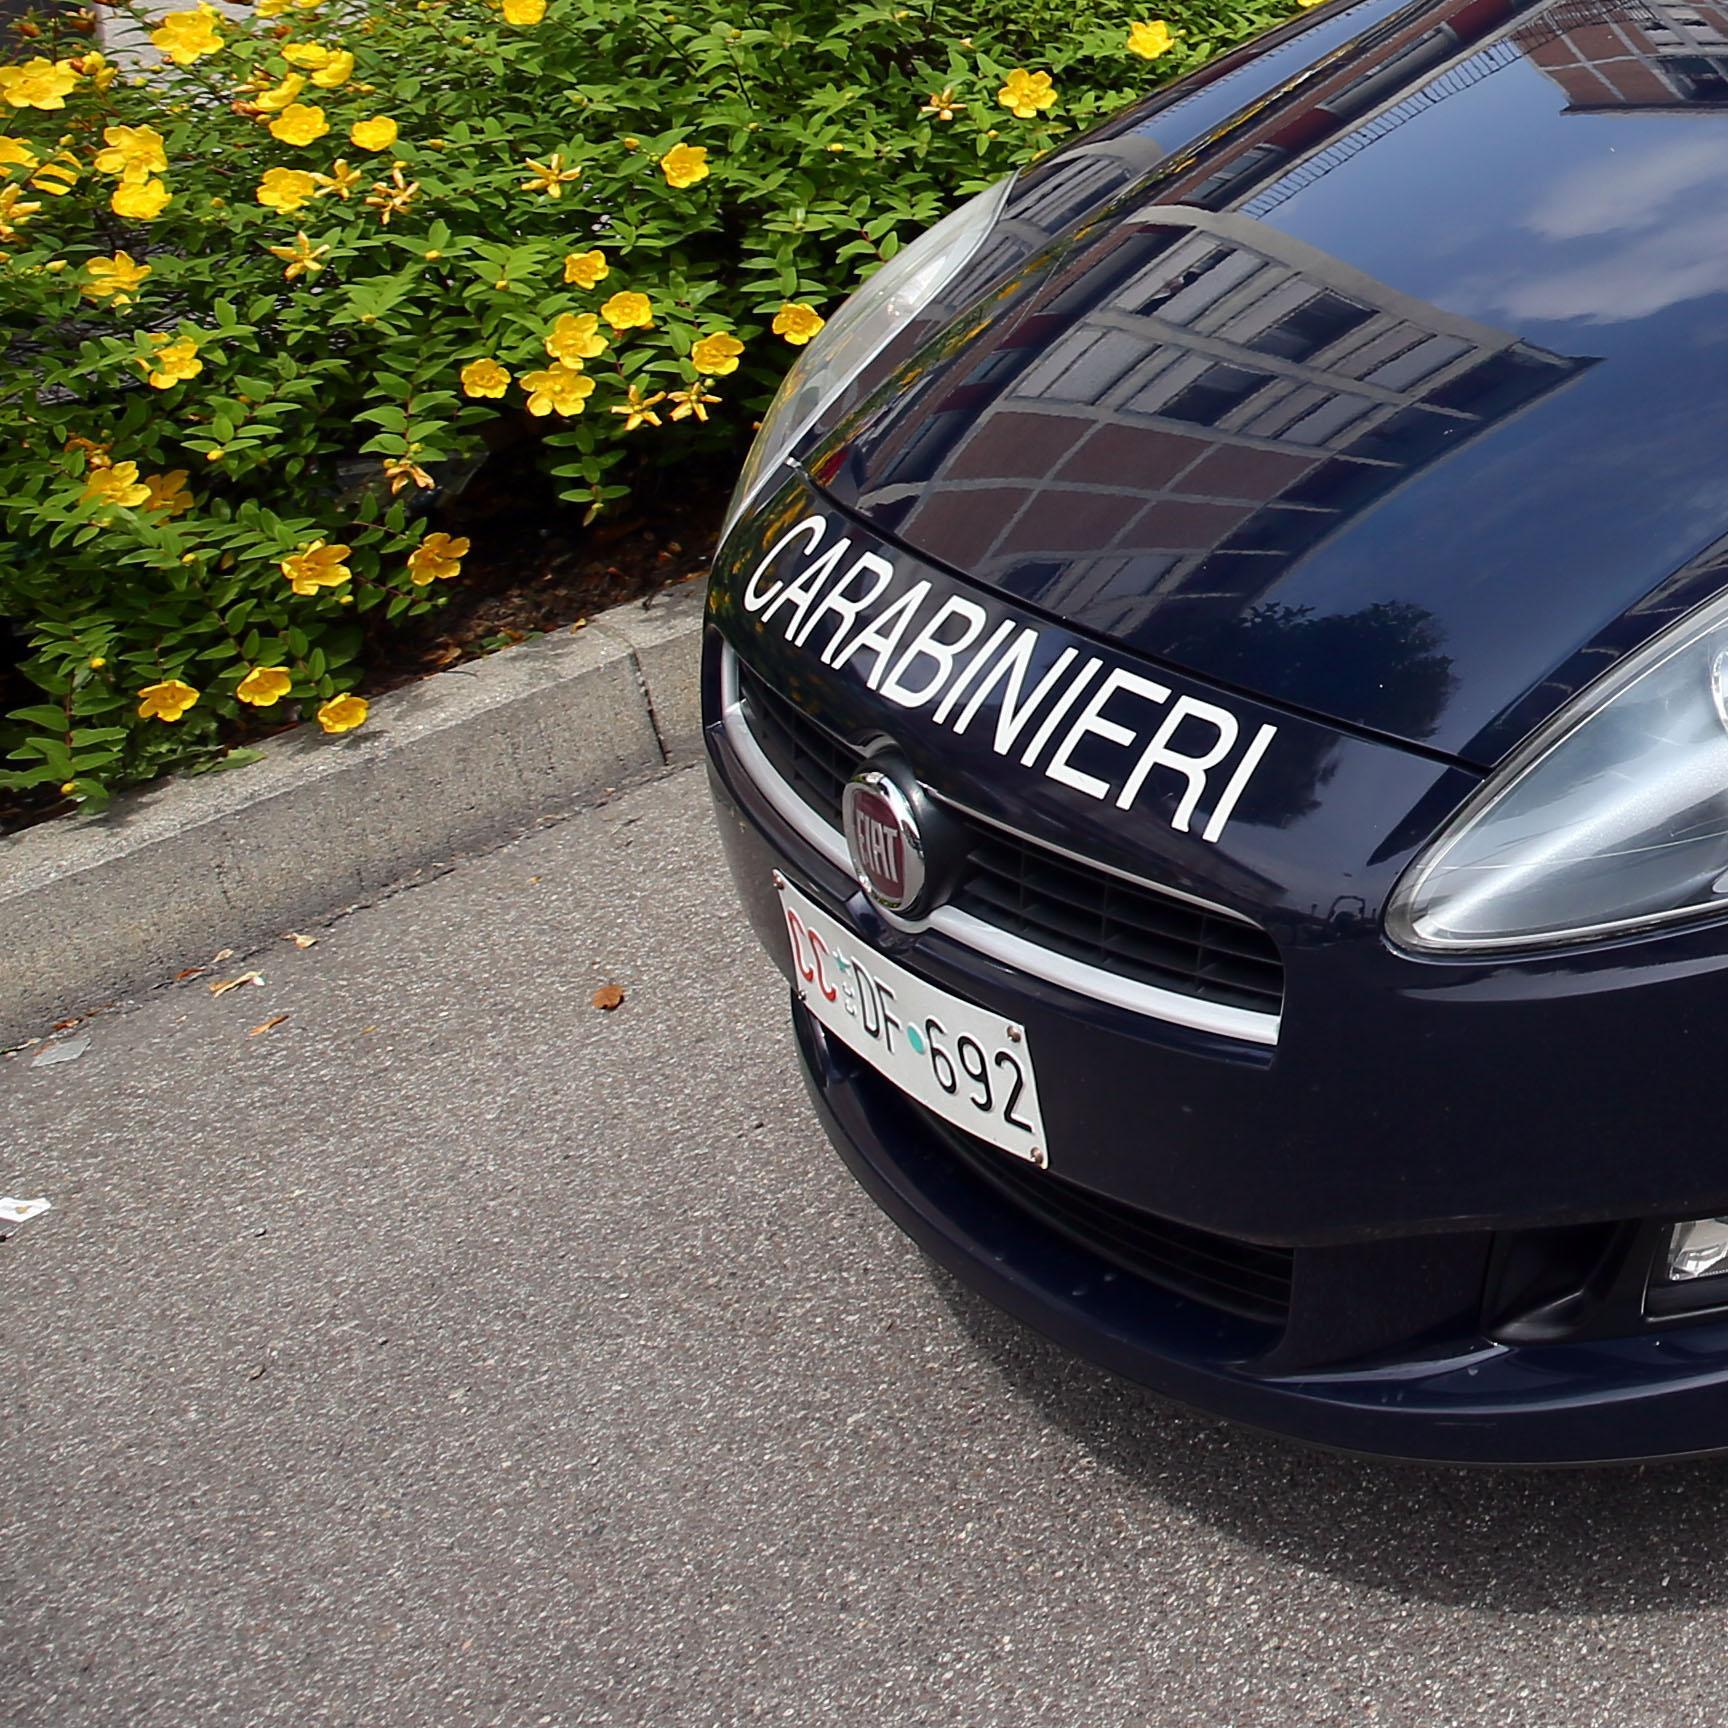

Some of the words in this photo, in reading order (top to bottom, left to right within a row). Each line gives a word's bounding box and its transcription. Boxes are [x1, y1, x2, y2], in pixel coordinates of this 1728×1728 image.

[743, 514, 1278, 844] CARABINIERI
[856, 809, 899, 883] FIAT
[787, 908, 837, 1003] CC
[851, 956, 903, 1054] DF
[925, 1015, 1035, 1135] 692
